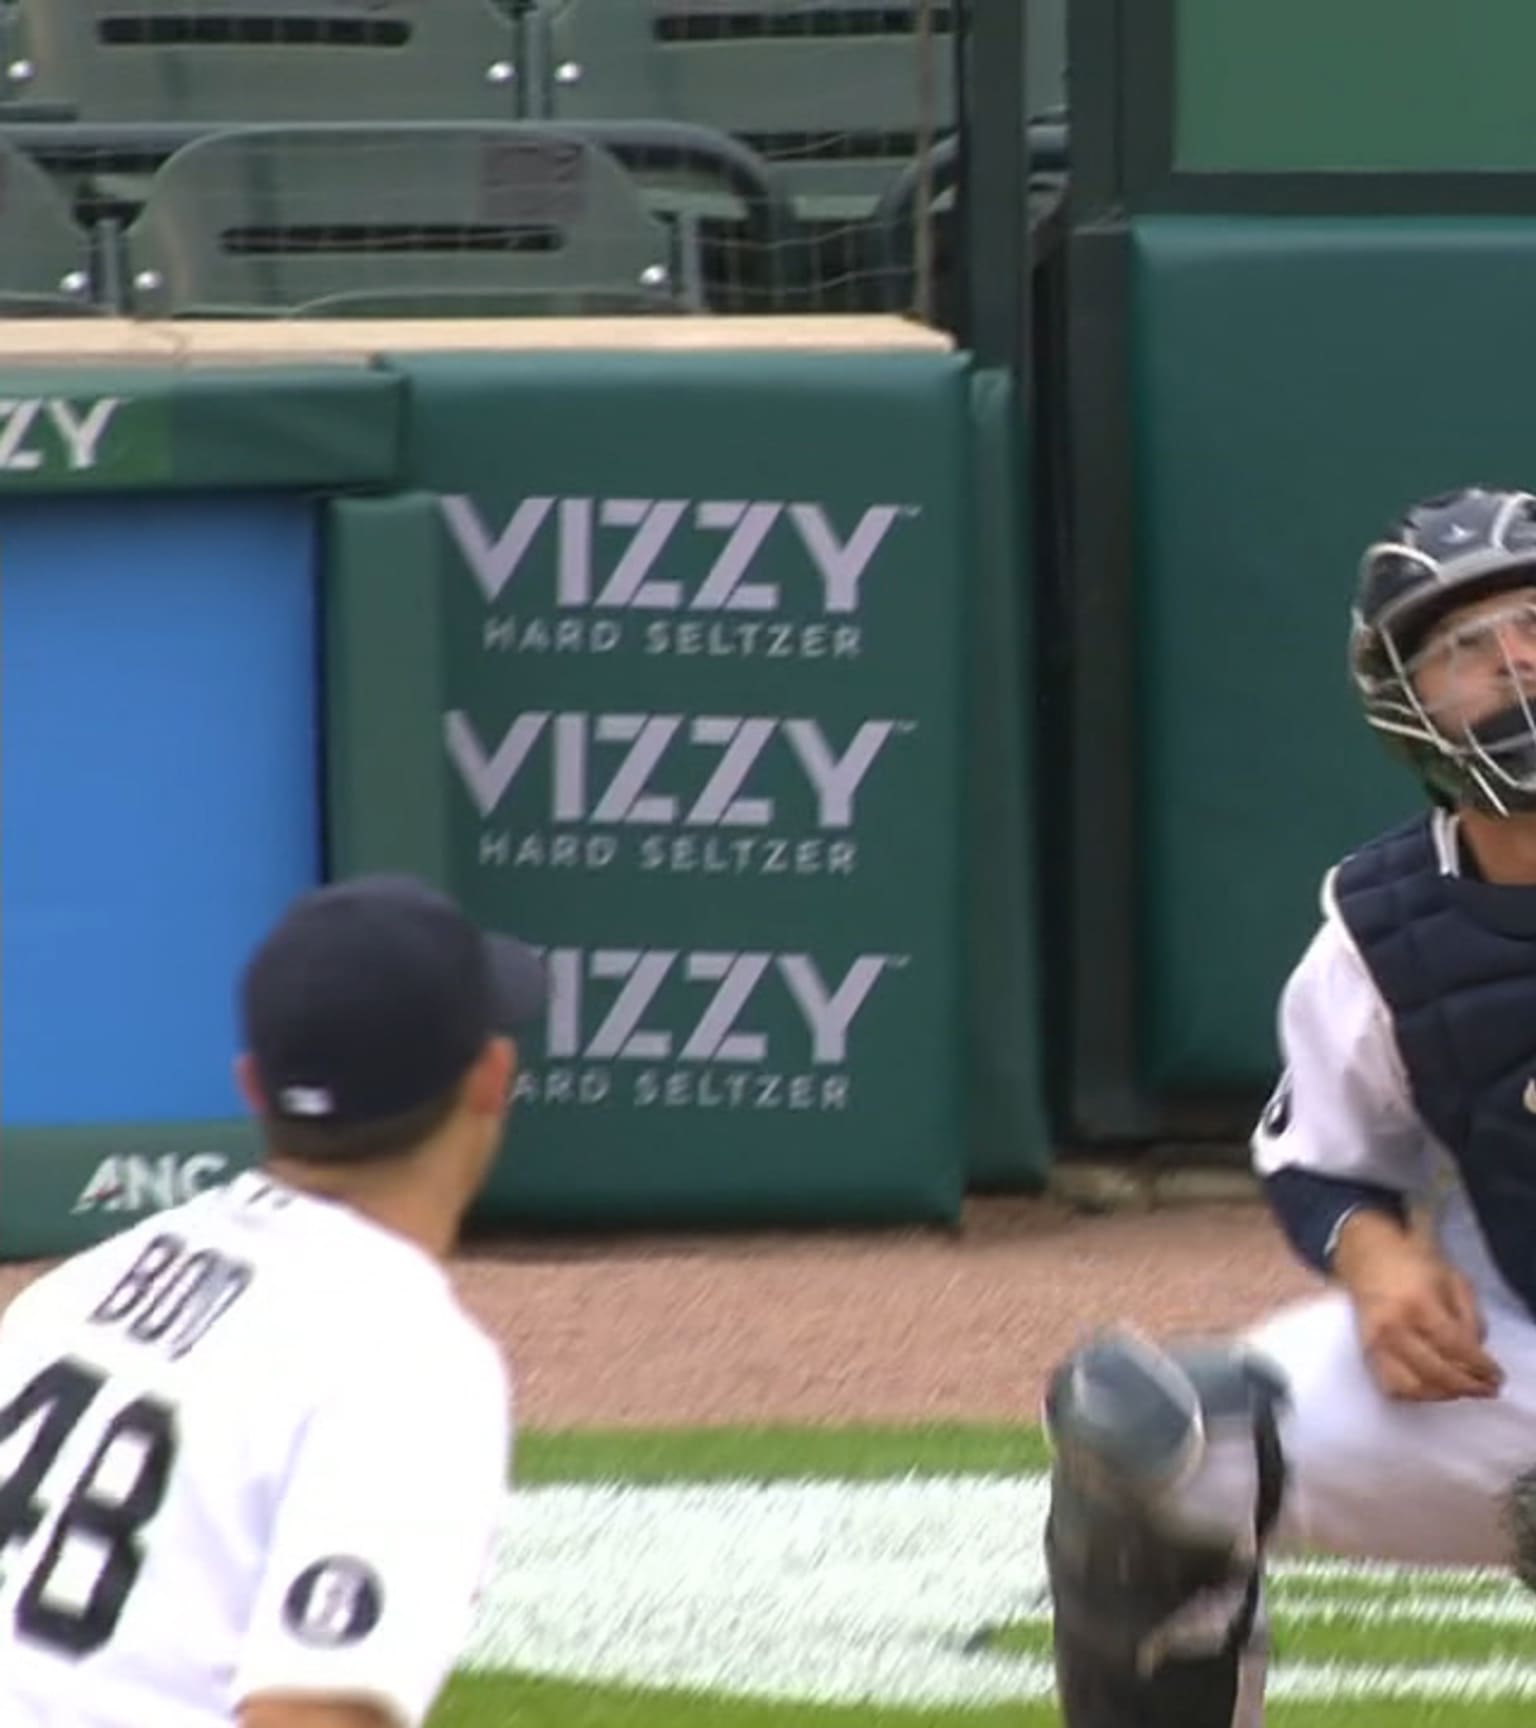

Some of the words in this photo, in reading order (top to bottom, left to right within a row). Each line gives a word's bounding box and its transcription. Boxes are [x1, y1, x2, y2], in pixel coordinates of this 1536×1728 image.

[440, 494, 901, 613] VIZZY
[482, 616, 622, 653] HARD
[643, 620, 863, 661] SELTZER
[444, 710, 896, 829] VIZZY
[478, 832, 618, 869] HARD
[640, 837, 858, 876] SELTZER
[530, 947, 888, 1066] IZZY
[510, 1069, 611, 1104] ARD
[632, 1073, 852, 1112] SELTZER
[0, 1354, 180, 1664] 48
